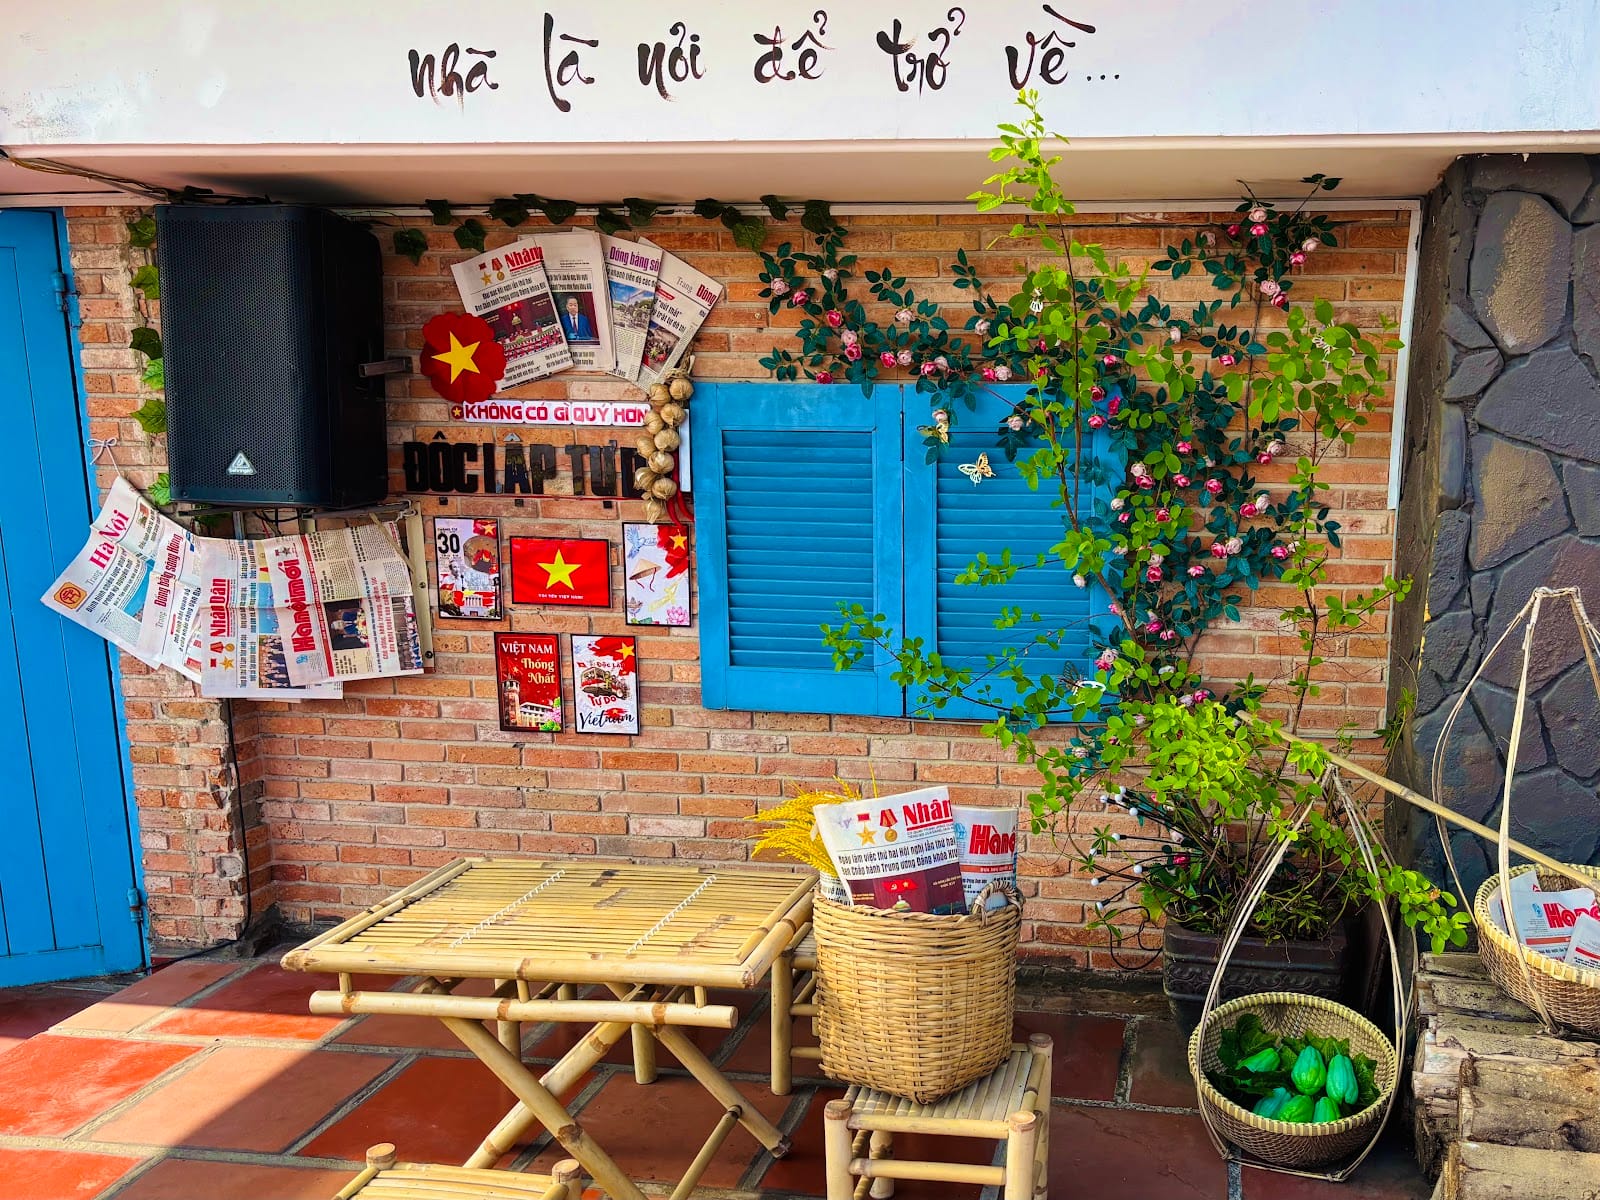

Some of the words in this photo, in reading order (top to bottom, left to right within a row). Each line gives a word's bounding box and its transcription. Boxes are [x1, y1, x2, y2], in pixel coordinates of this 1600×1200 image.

[543, 13, 599, 112] là
[754, 10, 830, 84] để
[465, 400, 523, 421] KHÔNG
[525, 401, 548, 421] CÓ
[553, 400, 569, 421] GÌ
[573, 402, 610, 423] QUÝ
[620, 446, 647, 498] D
[98, 509, 130, 543] Nội
[89, 539, 115, 570] Hà
[437, 533, 460, 554] 30
[209, 578, 226, 603] Dân
[210, 606, 226, 637] Nhân
[501, 640, 527, 656] VIỆT
[528, 643, 553, 655] NAM
[520, 657, 555, 673] Thống
[527, 672, 556, 685] Nhất
[604, 696, 617, 705] DO
[579, 709, 635, 730] Vietnam
[902, 799, 953, 826] Nhân
